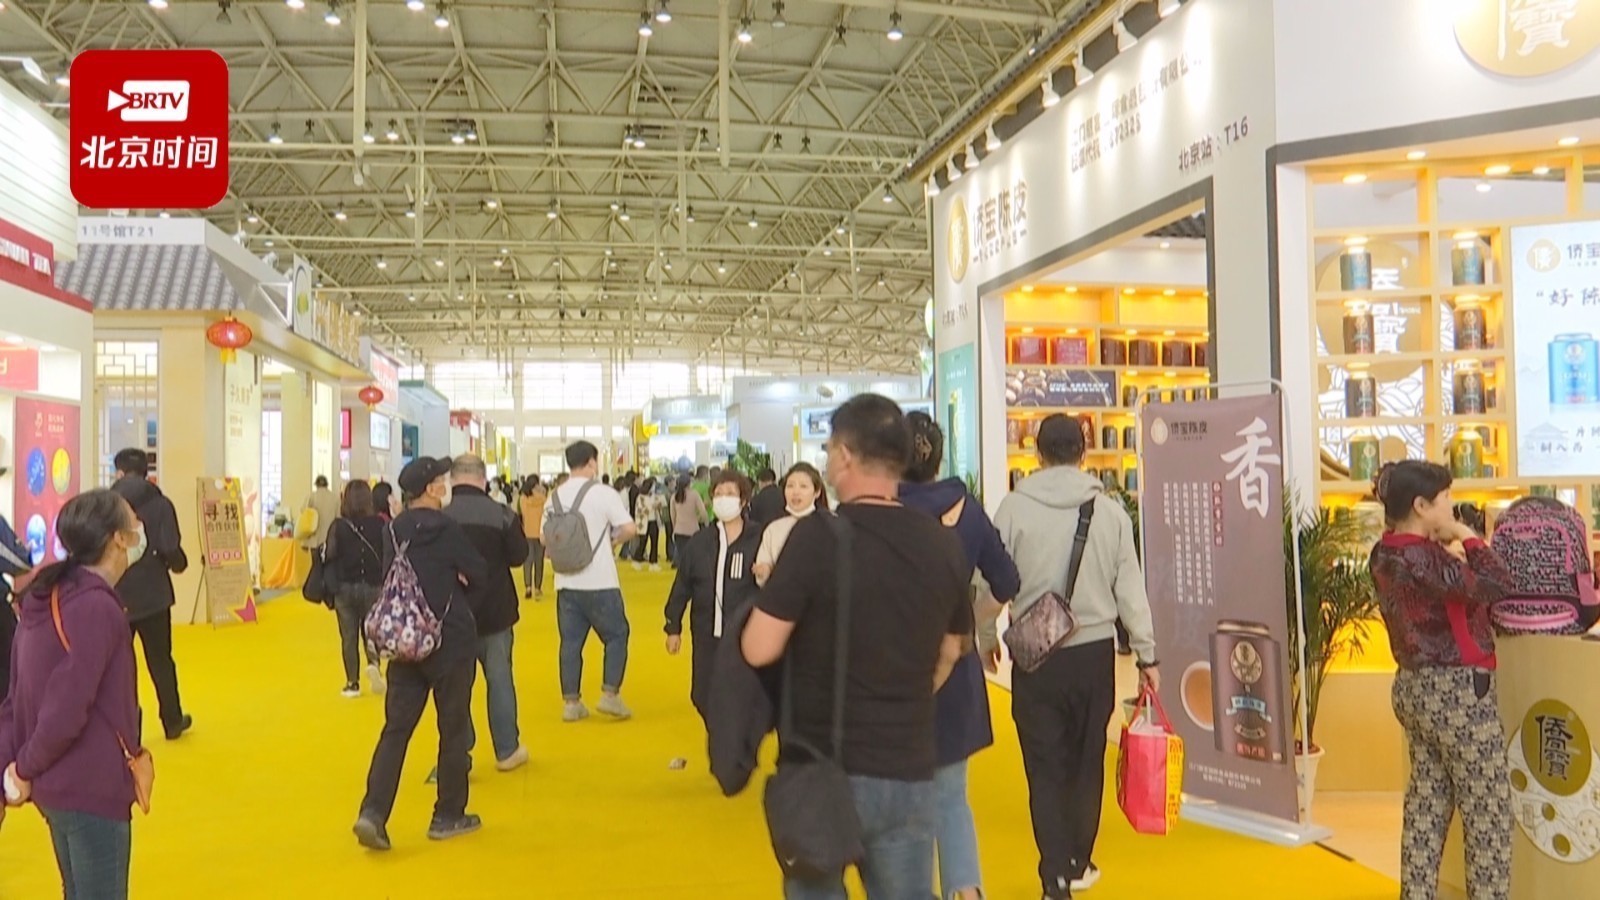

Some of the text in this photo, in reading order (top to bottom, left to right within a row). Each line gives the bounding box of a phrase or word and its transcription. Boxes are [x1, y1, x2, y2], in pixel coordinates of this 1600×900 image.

[973, 180, 1027, 248] 侨宝陈皮
[1220, 416, 1281, 519] 香
[206, 502, 239, 521] 寻找
